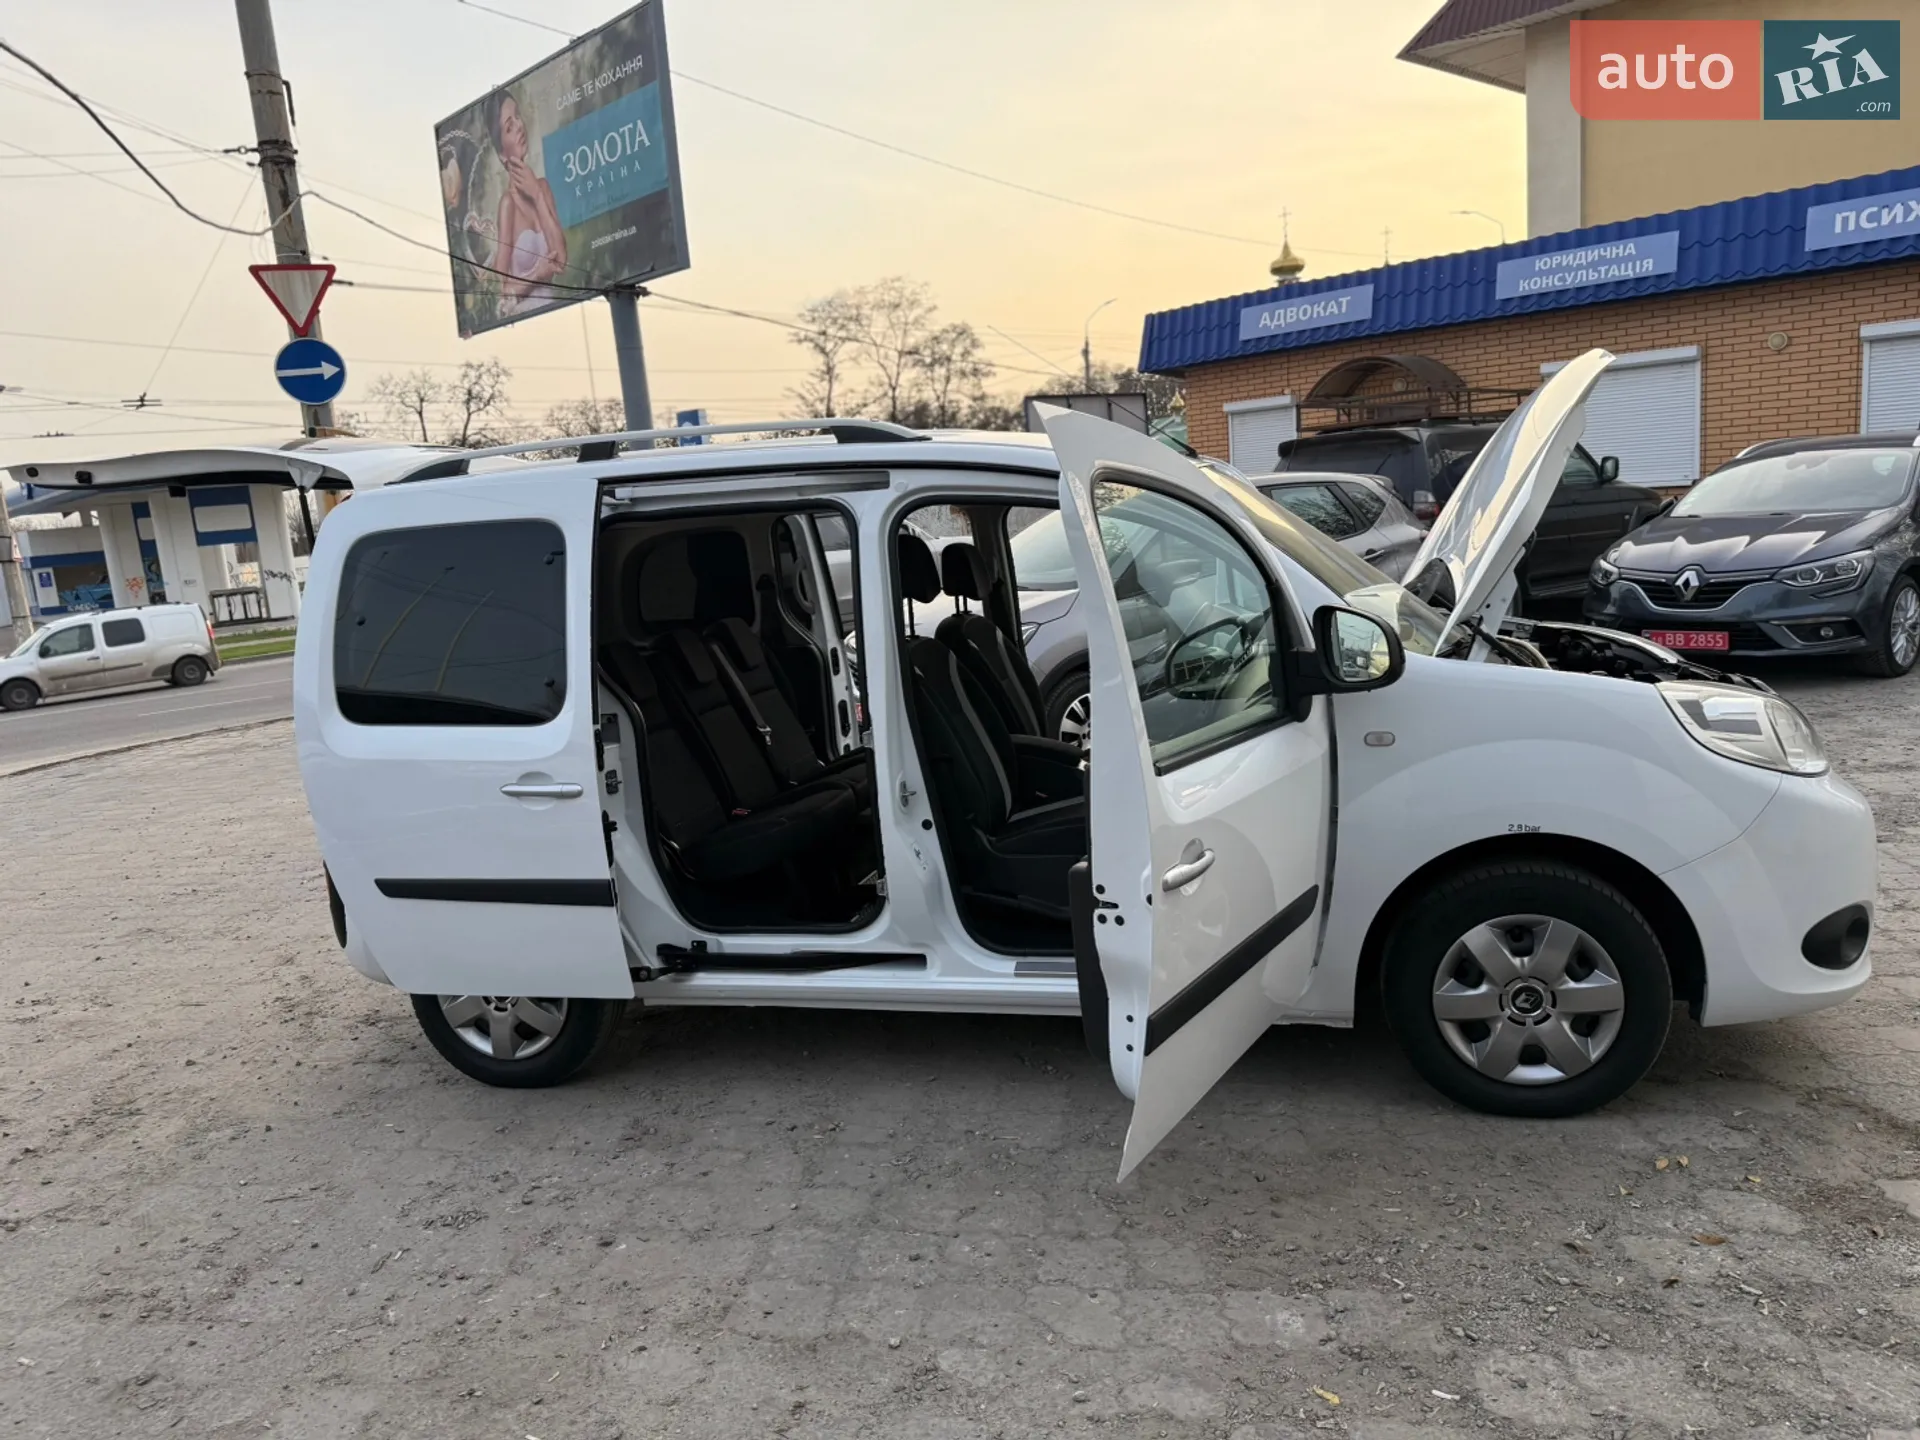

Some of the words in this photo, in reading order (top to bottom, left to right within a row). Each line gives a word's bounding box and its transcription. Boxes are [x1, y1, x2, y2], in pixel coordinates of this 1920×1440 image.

[556, 88, 582, 111] САМЕ
[582, 80, 595, 97] ТЕ
[594, 54, 643, 92] КОХАННЯ
[562, 119, 651, 182] ЗОЛОТА
[1534, 242, 1637, 272] ЮРИДИЧНА
[1518, 258, 1654, 292] КОНСУЛЬТАЦІЯ
[1258, 296, 1352, 329] АДВОКАТ
[1689, 634, 1724, 647] 2855
[1524, 823, 1541, 832] bar
